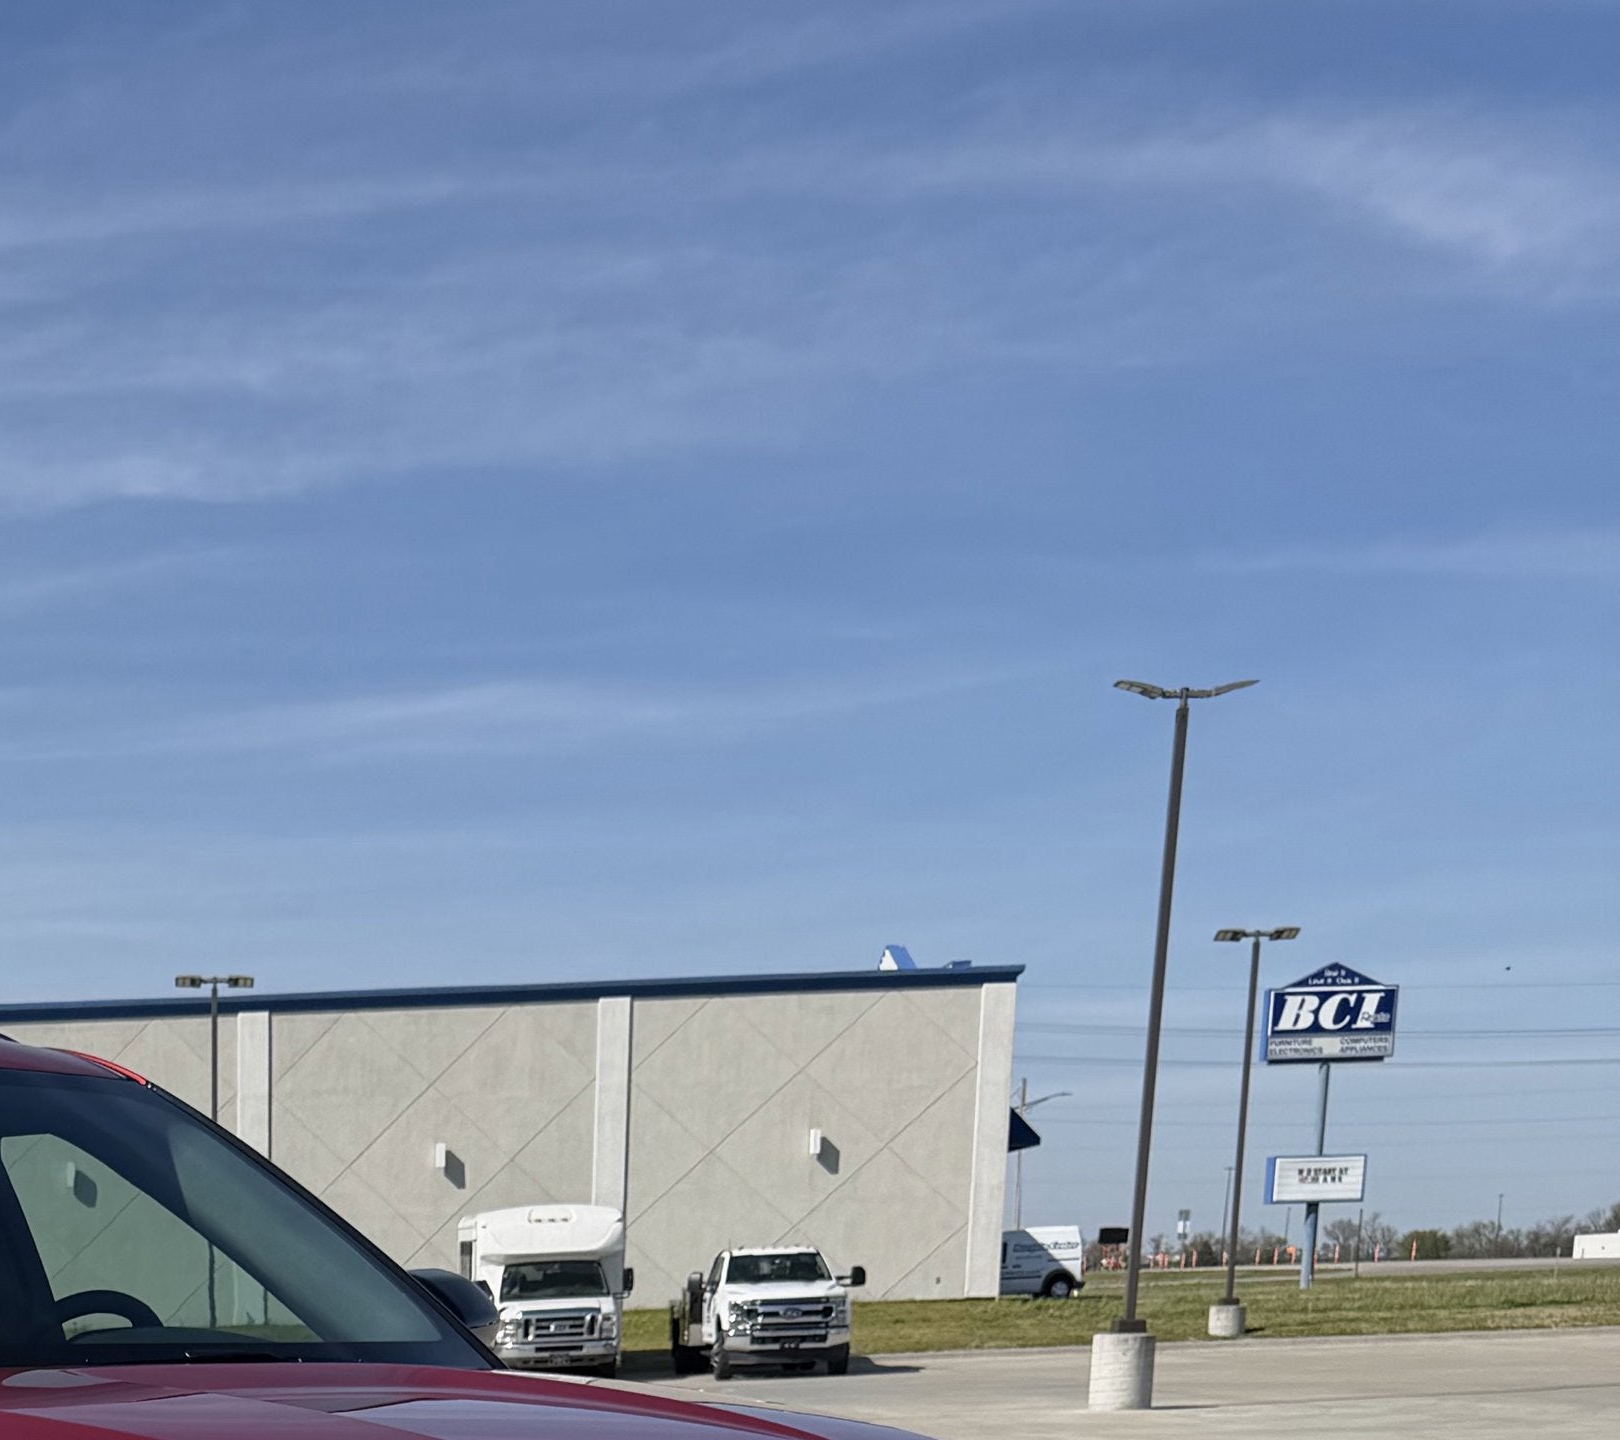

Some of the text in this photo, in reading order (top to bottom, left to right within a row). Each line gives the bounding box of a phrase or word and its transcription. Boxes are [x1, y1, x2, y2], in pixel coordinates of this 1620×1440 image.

[1273, 992, 1386, 1031] BCI
[1269, 1039, 1313, 1047] FURNITURE
[1340, 1037, 1390, 1045] COMPUTERS
[1269, 1047, 1324, 1056] ELECTRONICS
[1339, 1045, 1388, 1054] APPLIANCES
